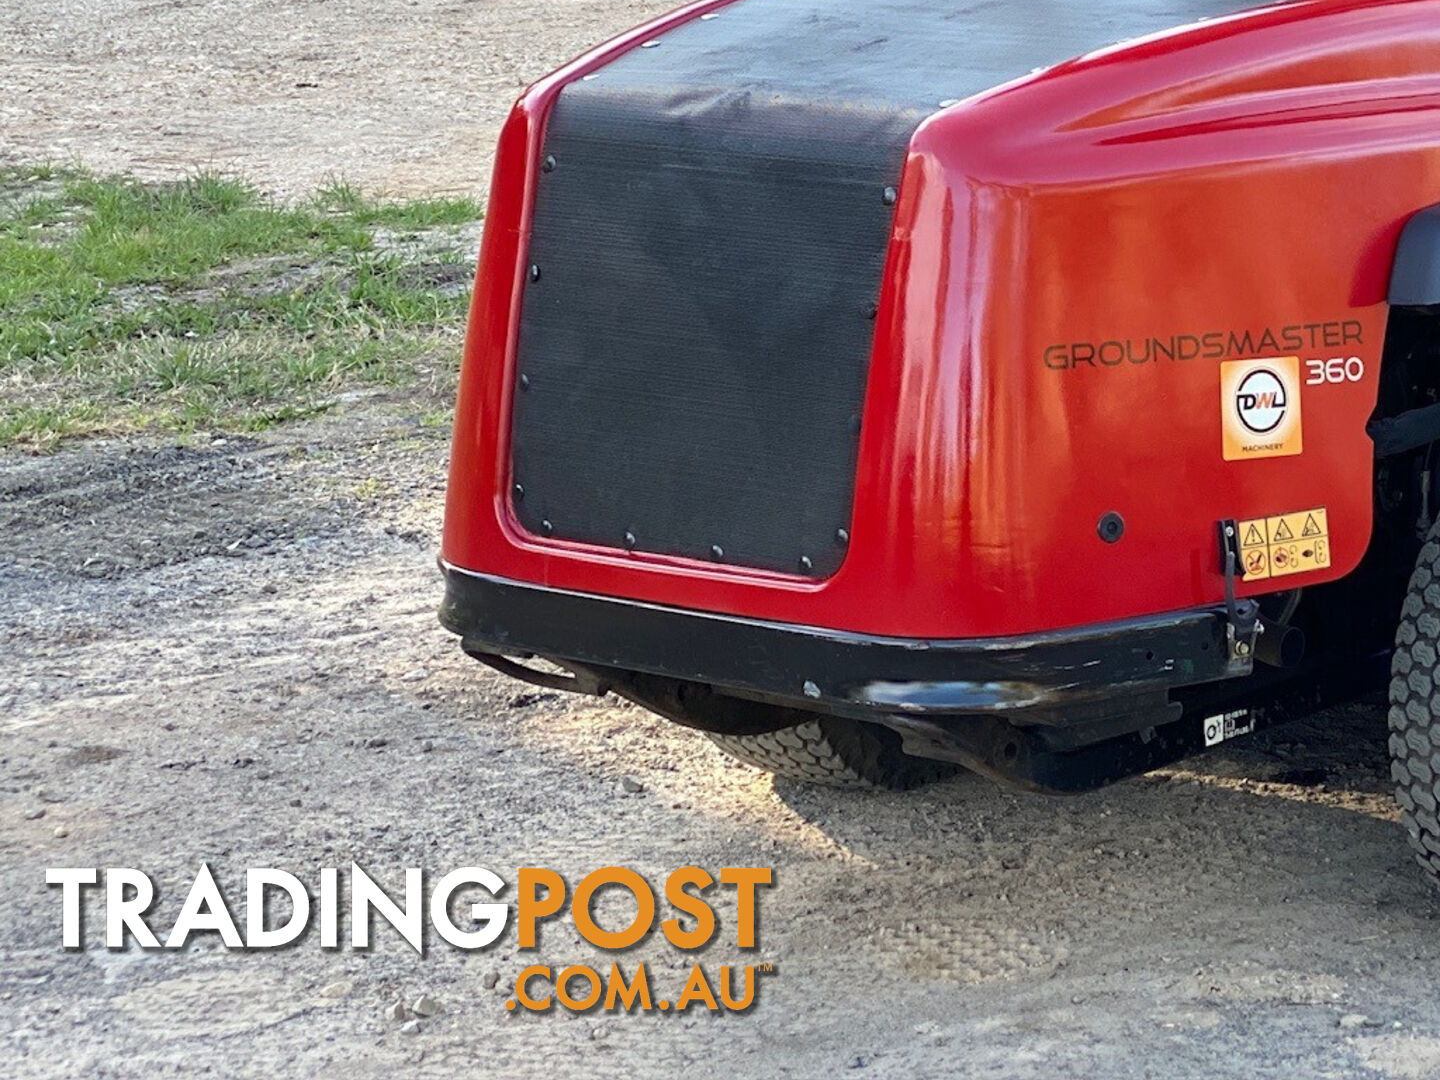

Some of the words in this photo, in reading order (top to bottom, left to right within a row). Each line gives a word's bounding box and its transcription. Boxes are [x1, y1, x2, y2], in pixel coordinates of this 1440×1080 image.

[1043, 320, 1364, 370] GROUNDSMASTER
[1305, 356, 1365, 385] 360
[1238, 391, 1286, 411] DWL
[1242, 442, 1284, 453] MACHINERY
